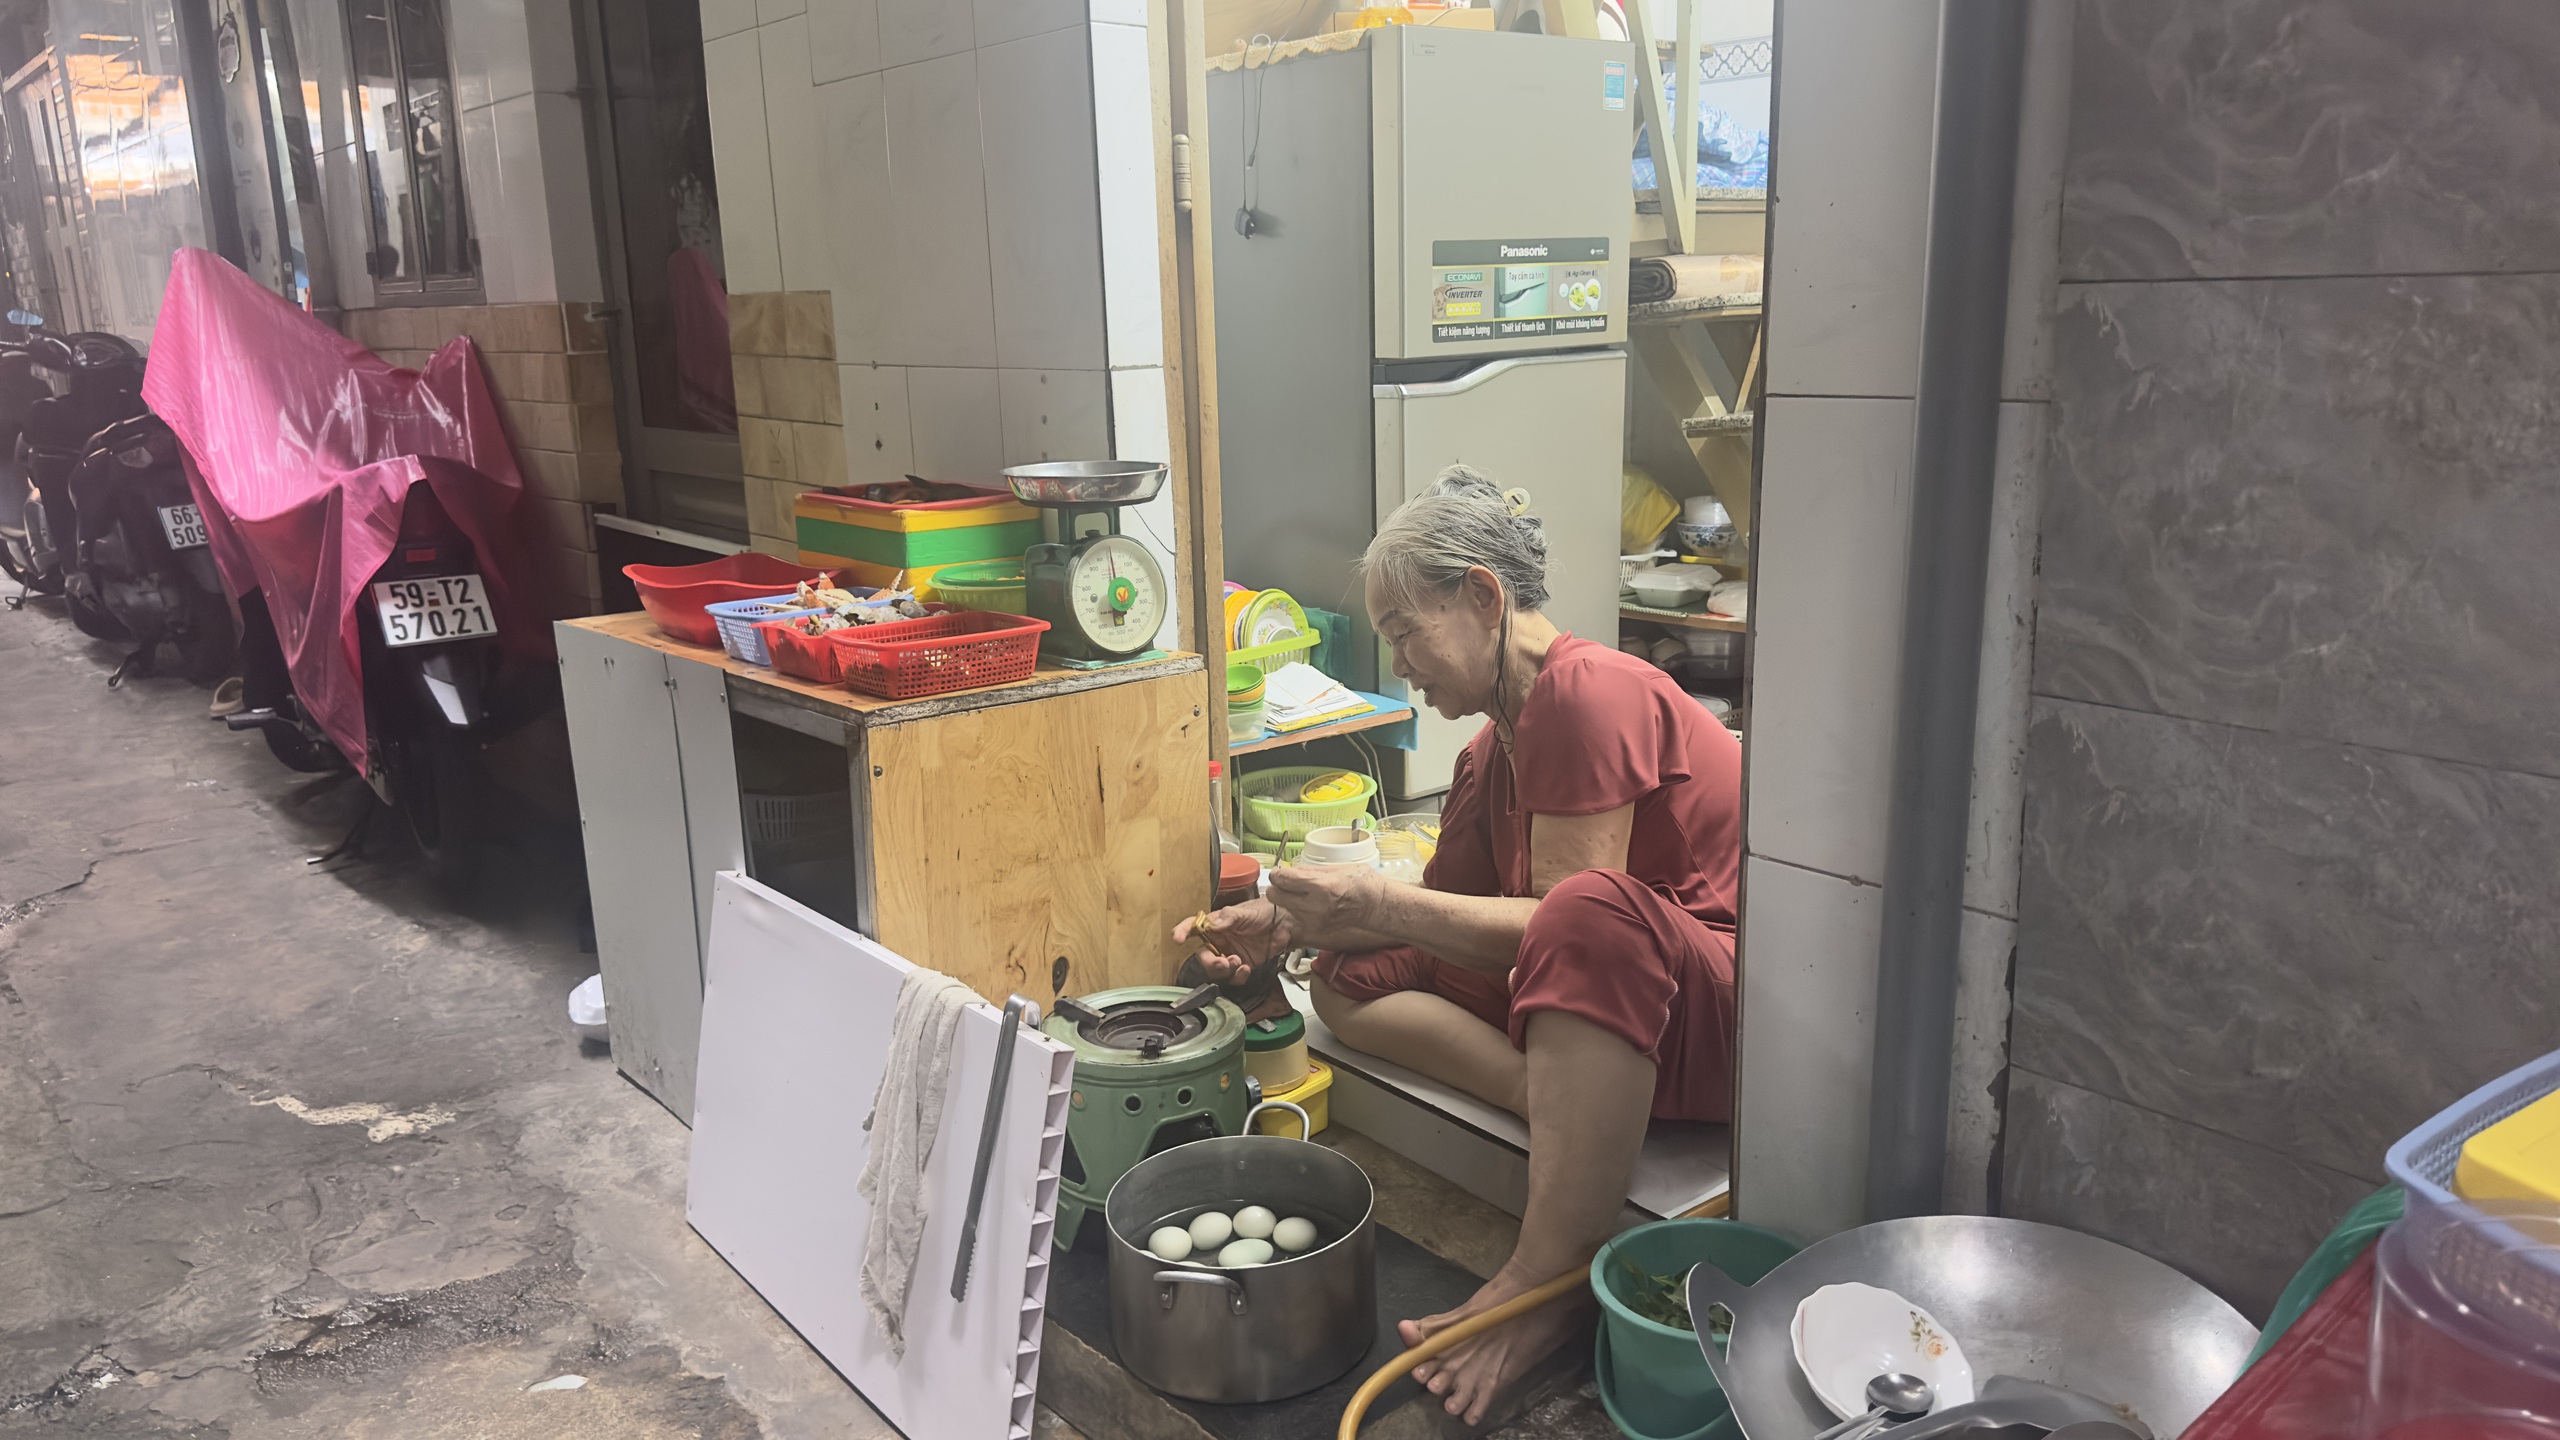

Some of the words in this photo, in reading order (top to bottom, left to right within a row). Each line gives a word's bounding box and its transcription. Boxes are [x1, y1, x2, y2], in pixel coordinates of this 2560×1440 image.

[1500, 244, 1548, 257] Panasonic
[1447, 274, 1481, 282] ECONAVI
[1448, 290, 1483, 299] INVERTER
[1437, 326, 1448, 337] Tiết
[1449, 326, 1462, 338] kiệm
[1462, 326, 1475, 337] năng
[1501, 322, 1514, 333] Thiết
[1522, 322, 1536, 332] thanh
[172, 524, 208, 546] 509
[388, 577, 475, 610] 59-T2
[389, 605, 489, 641] 570.21
